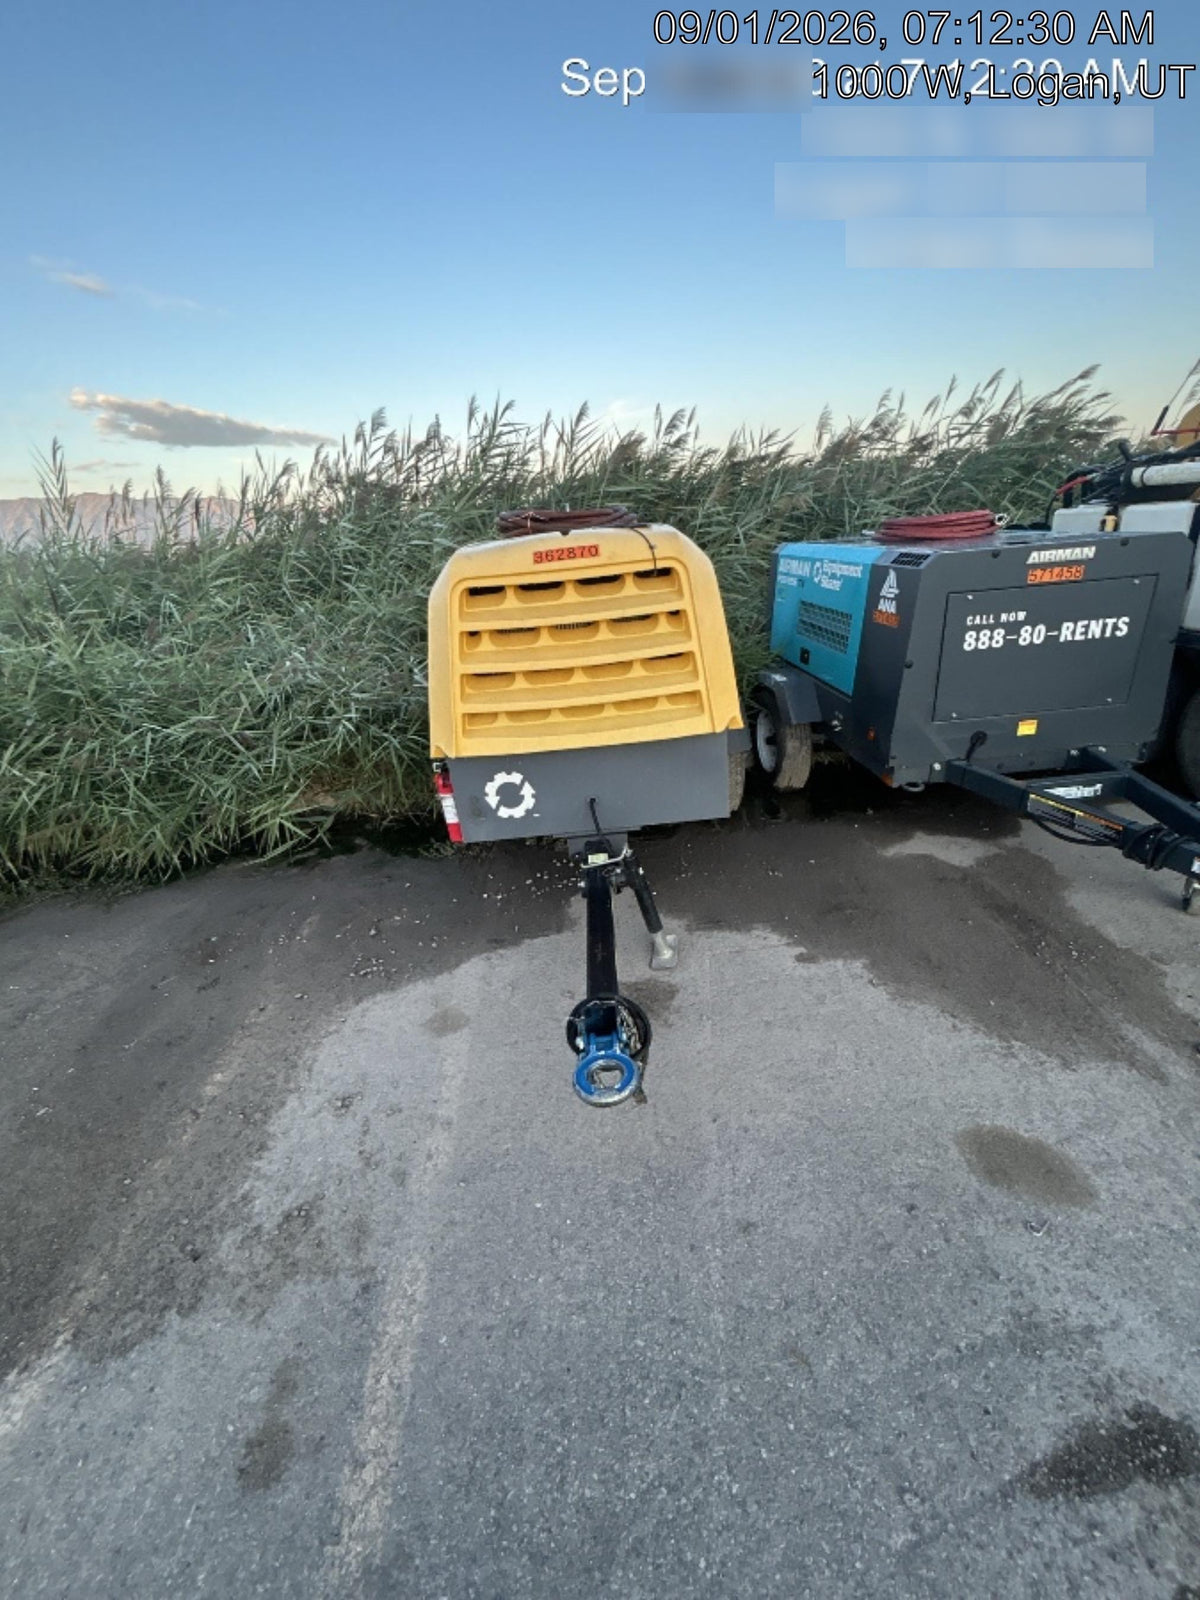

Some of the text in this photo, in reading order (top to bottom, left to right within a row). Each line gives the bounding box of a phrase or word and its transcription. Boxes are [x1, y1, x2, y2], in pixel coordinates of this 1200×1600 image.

[533, 545, 599, 564] 362870
[1026, 546, 1096, 564] AIRMAN
[1028, 565, 1085, 583] 571458
[966, 611, 1028, 626] CALL NOW
[962, 616, 1131, 652] 888-80-RENTS
